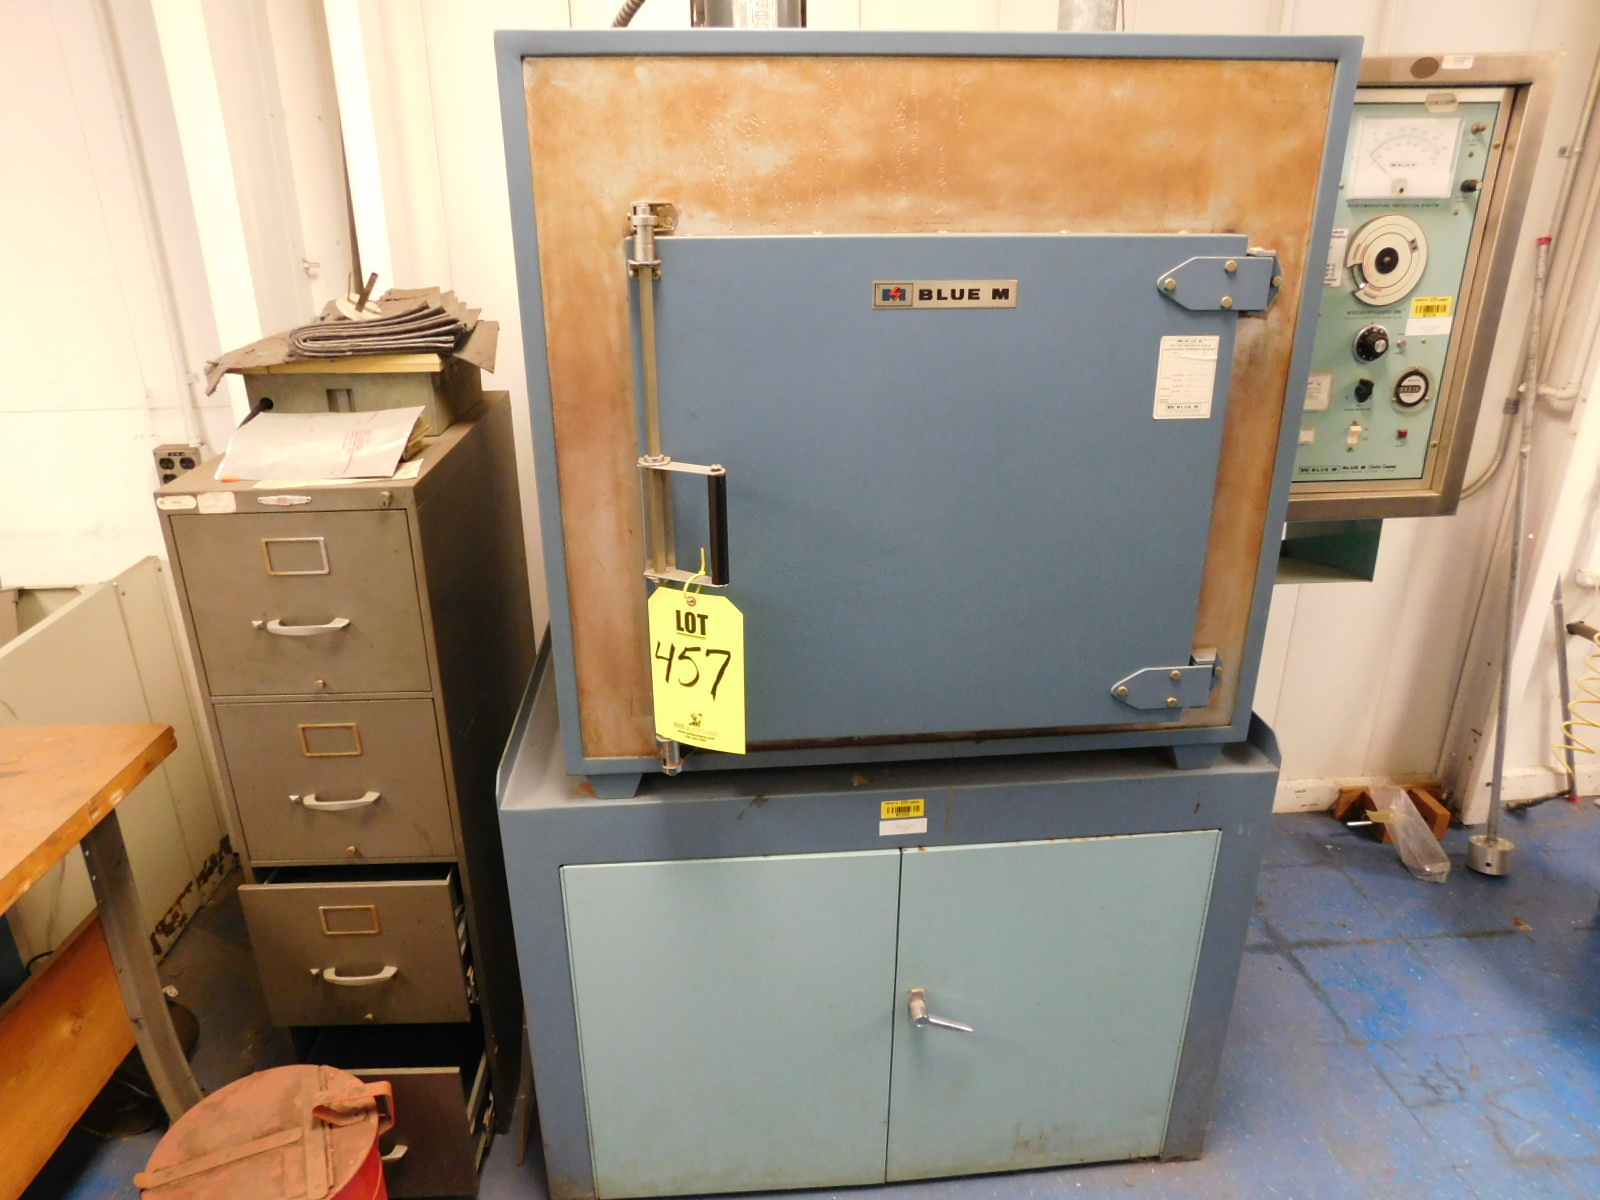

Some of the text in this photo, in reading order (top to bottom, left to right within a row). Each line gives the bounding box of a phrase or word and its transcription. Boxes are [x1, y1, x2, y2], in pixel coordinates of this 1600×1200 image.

[918, 288, 981, 301] BLUE
[991, 288, 1010, 300] M
[675, 610, 708, 636] LOT
[655, 640, 732, 702] 457
